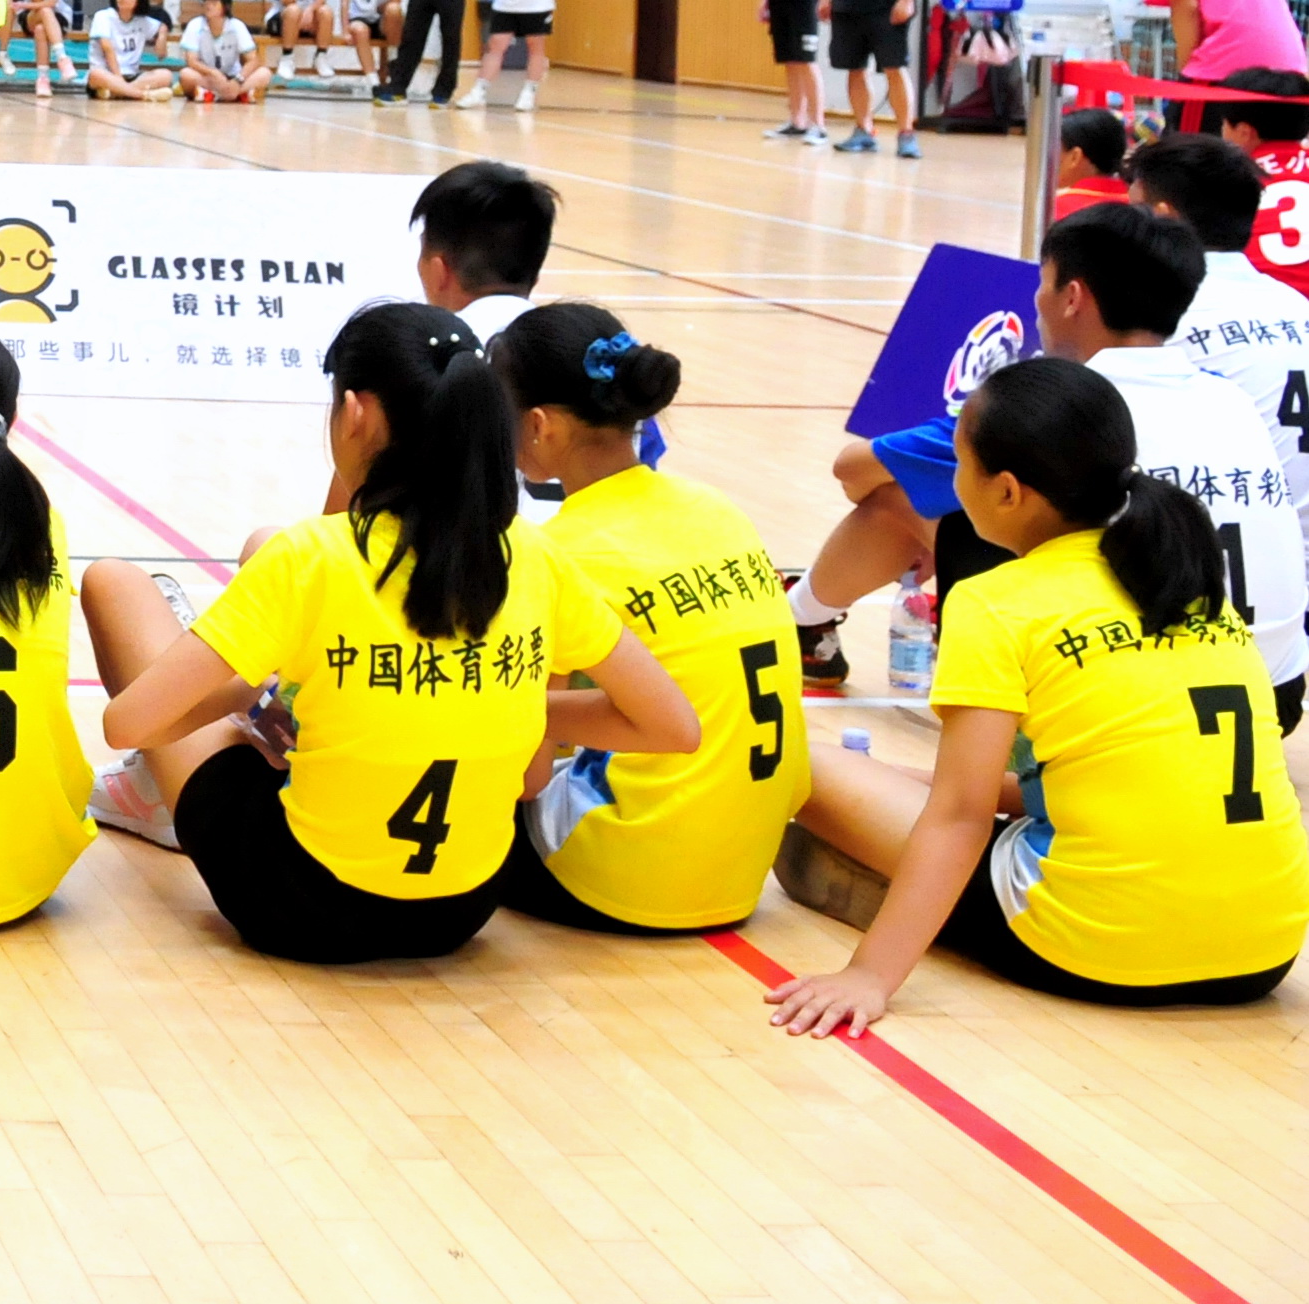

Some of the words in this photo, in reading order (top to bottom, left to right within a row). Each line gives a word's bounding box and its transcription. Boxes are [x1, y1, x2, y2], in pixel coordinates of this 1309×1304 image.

[1258, 180, 1309, 266] 3
[107, 254, 245, 283] GLASSES
[261, 258, 345, 285] PLAN
[172, 292, 284, 320] 镜计划
[1147, 464, 1294, 509] 国体育彩
[325, 625, 545, 698] 中国体育彩票
[739, 638, 784, 783] 5
[1188, 684, 1265, 825] 7
[386, 758, 458, 876] 4
